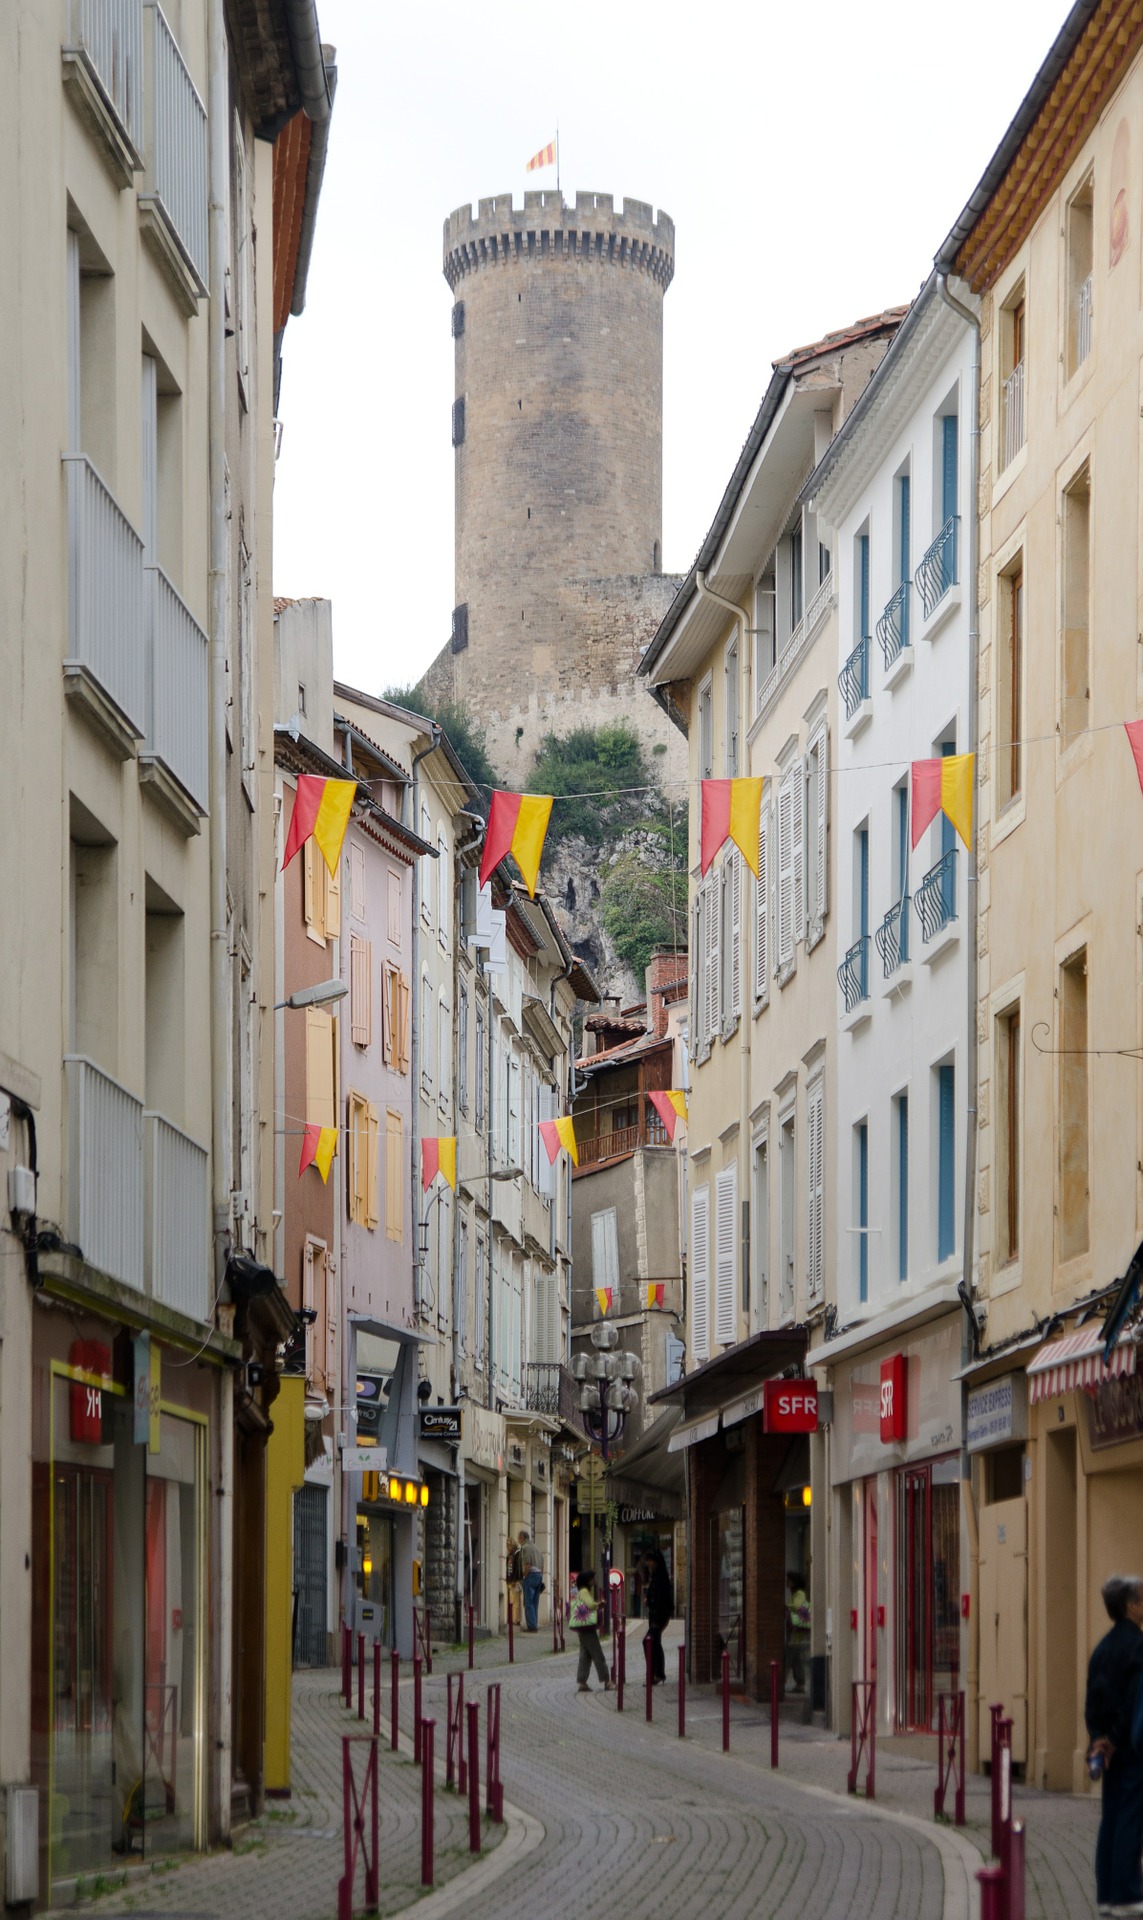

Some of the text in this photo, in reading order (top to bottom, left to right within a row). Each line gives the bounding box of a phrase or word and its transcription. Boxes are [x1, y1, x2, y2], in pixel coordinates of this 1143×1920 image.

[778, 1397, 817, 1415] SFR
[881, 1380, 894, 1419] SFR
[968, 1386, 1011, 1419] SERVICE EXPRESS
[424, 1415, 458, 1431] Century 21
